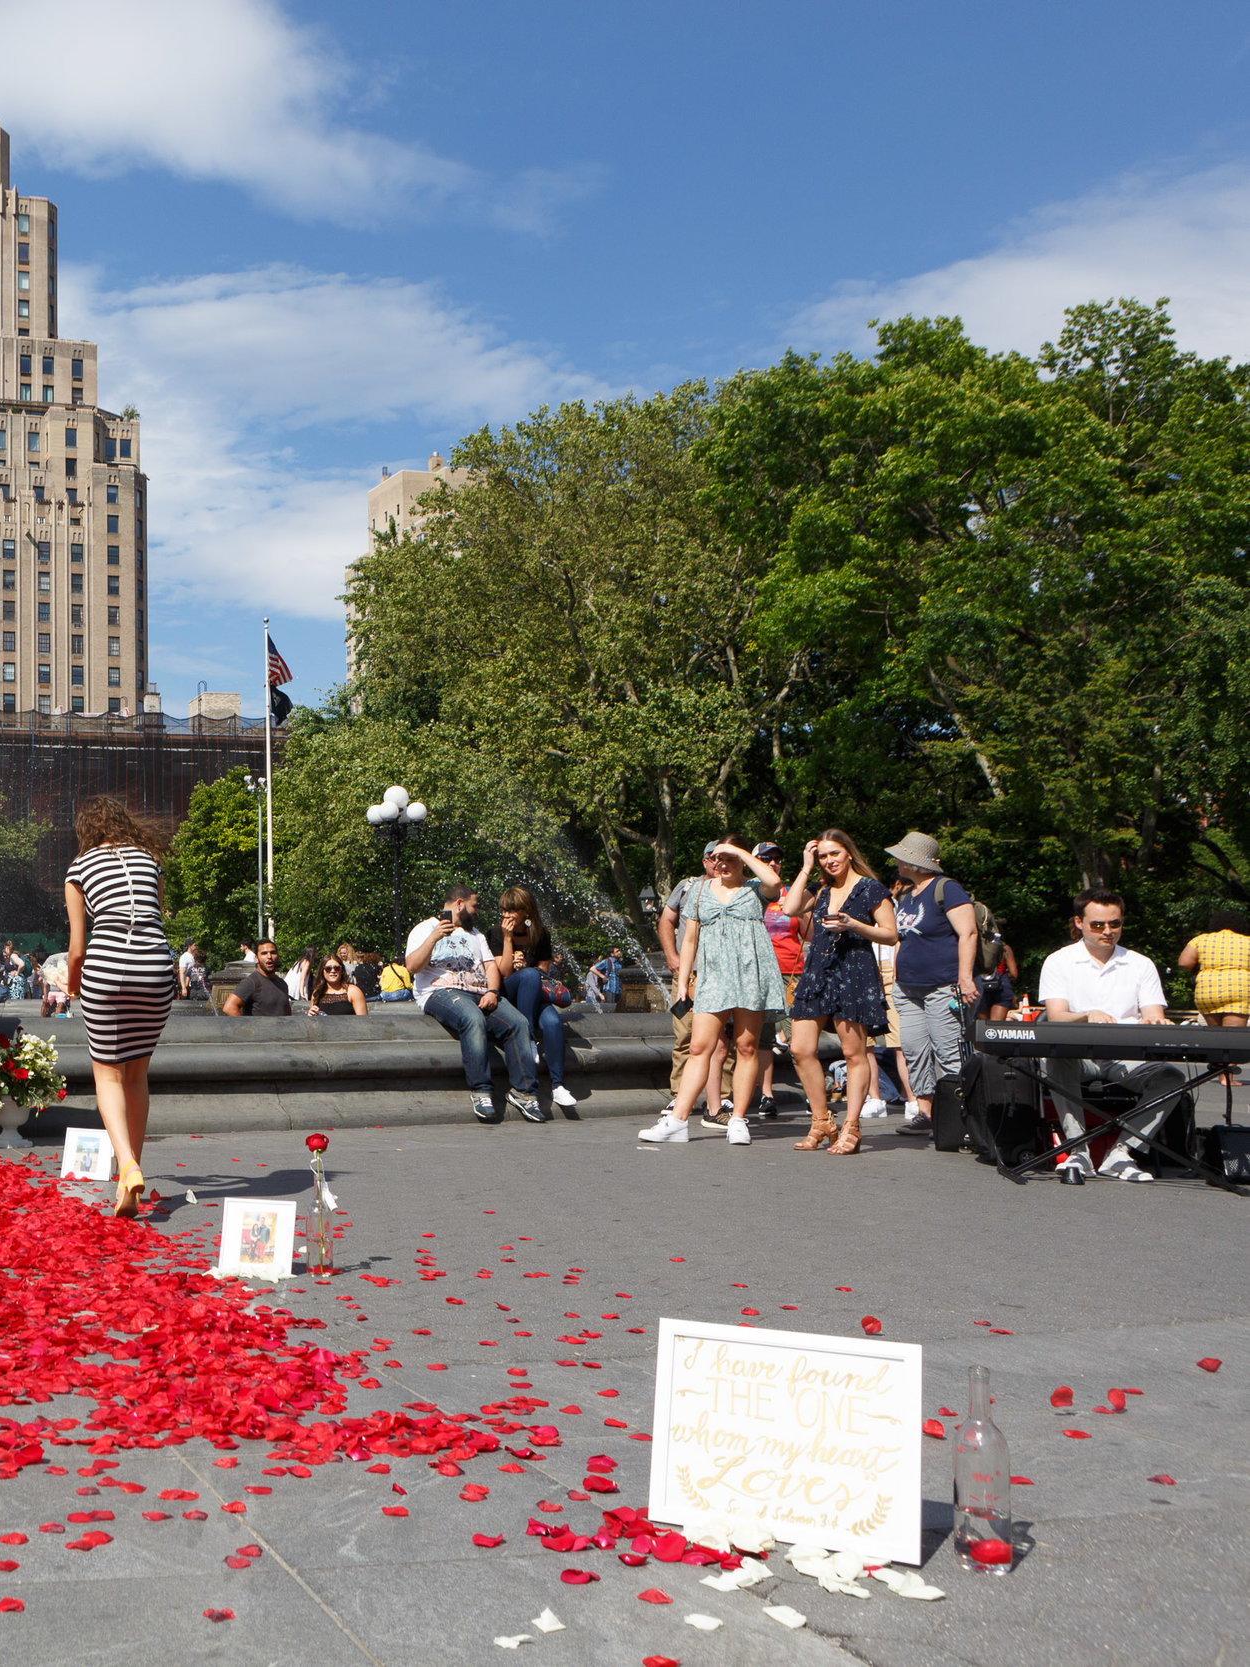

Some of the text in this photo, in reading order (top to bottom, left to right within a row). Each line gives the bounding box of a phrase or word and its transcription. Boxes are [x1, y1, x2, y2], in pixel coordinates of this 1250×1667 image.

[996, 1029, 1036, 1040] YAMAHA
[710, 1343, 783, 1379] have
[786, 1355, 894, 1398] found
[705, 1376, 872, 1436] THE ONE
[669, 1410, 902, 1473] whom my heart
